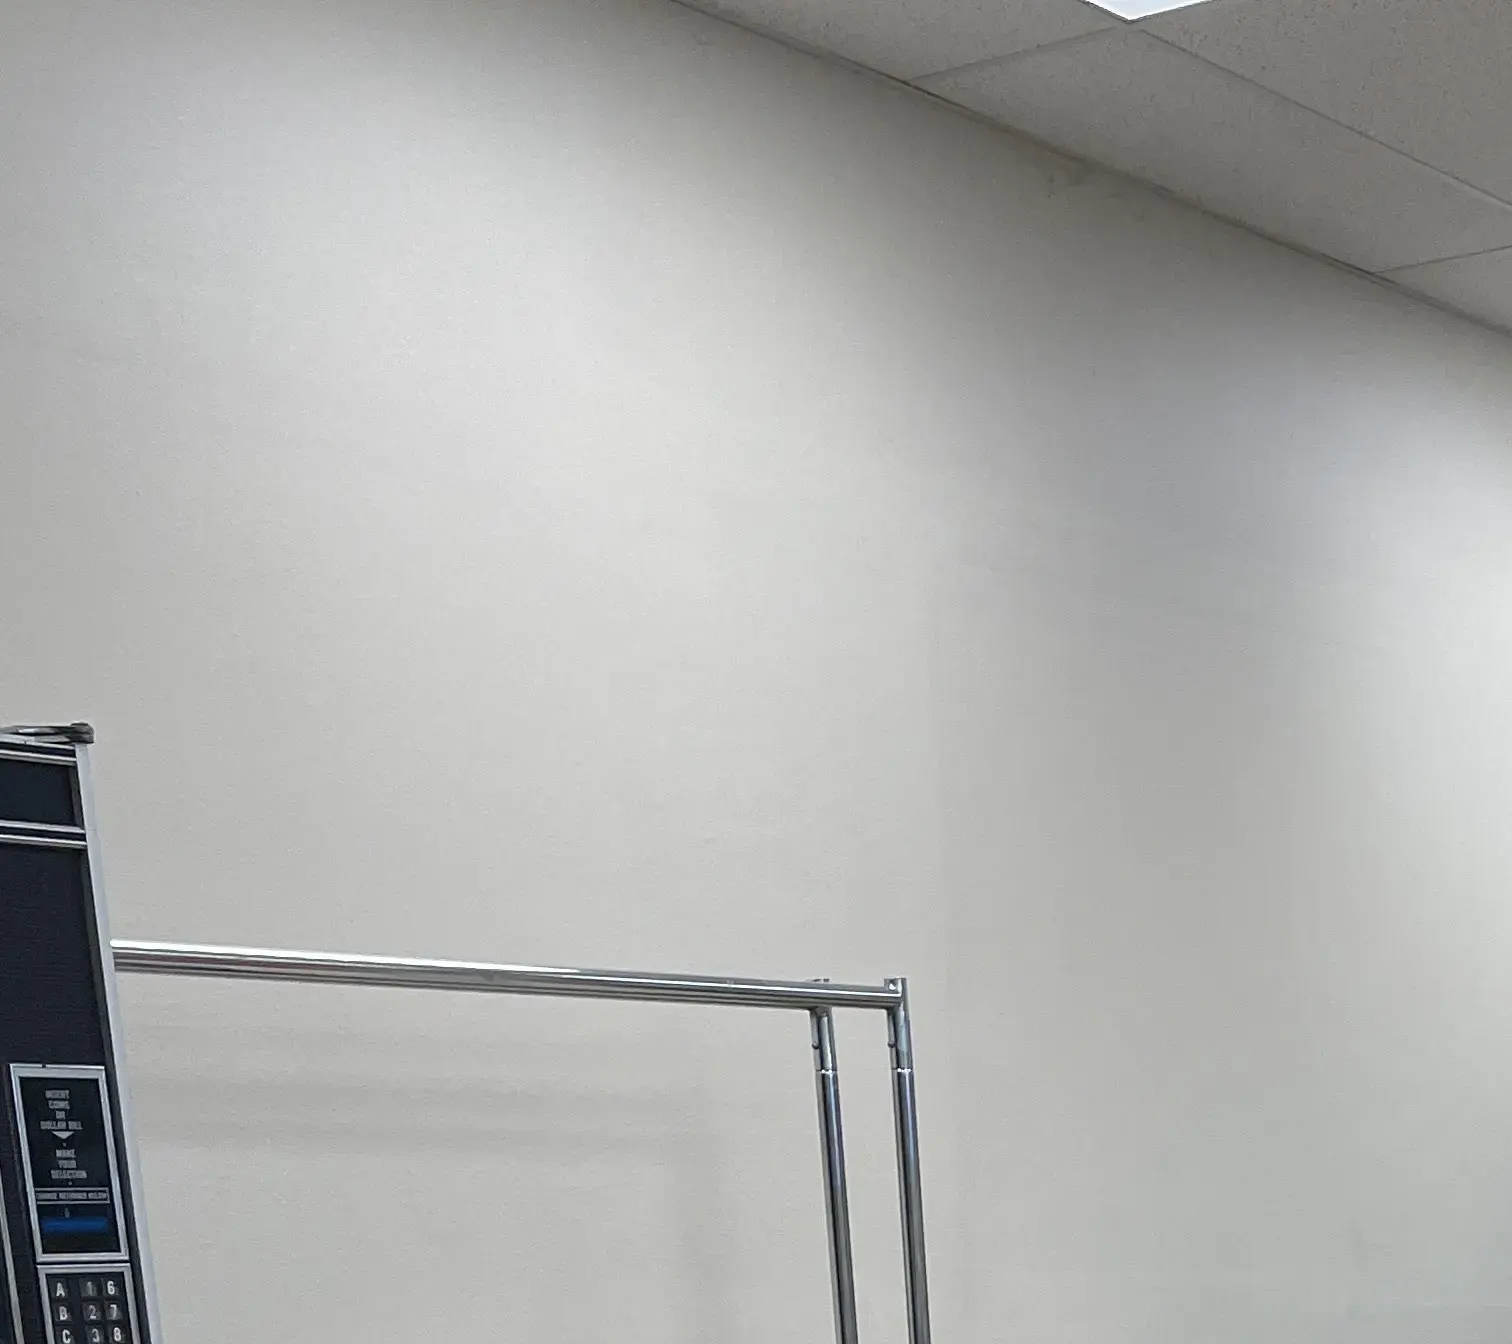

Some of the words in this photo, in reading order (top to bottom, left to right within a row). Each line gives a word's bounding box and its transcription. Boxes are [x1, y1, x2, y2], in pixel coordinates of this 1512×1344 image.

[56, 1282, 66, 1297] A
[86, 1281, 94, 1296] 1
[106, 1280, 115, 1295] 6
[59, 1306, 68, 1321] B
[88, 1305, 97, 1319] 2
[110, 1304, 117, 1319] 7
[62, 1329, 71, 1344] C
[92, 1328, 100, 1342] 3
[113, 1327, 122, 1341] 8
